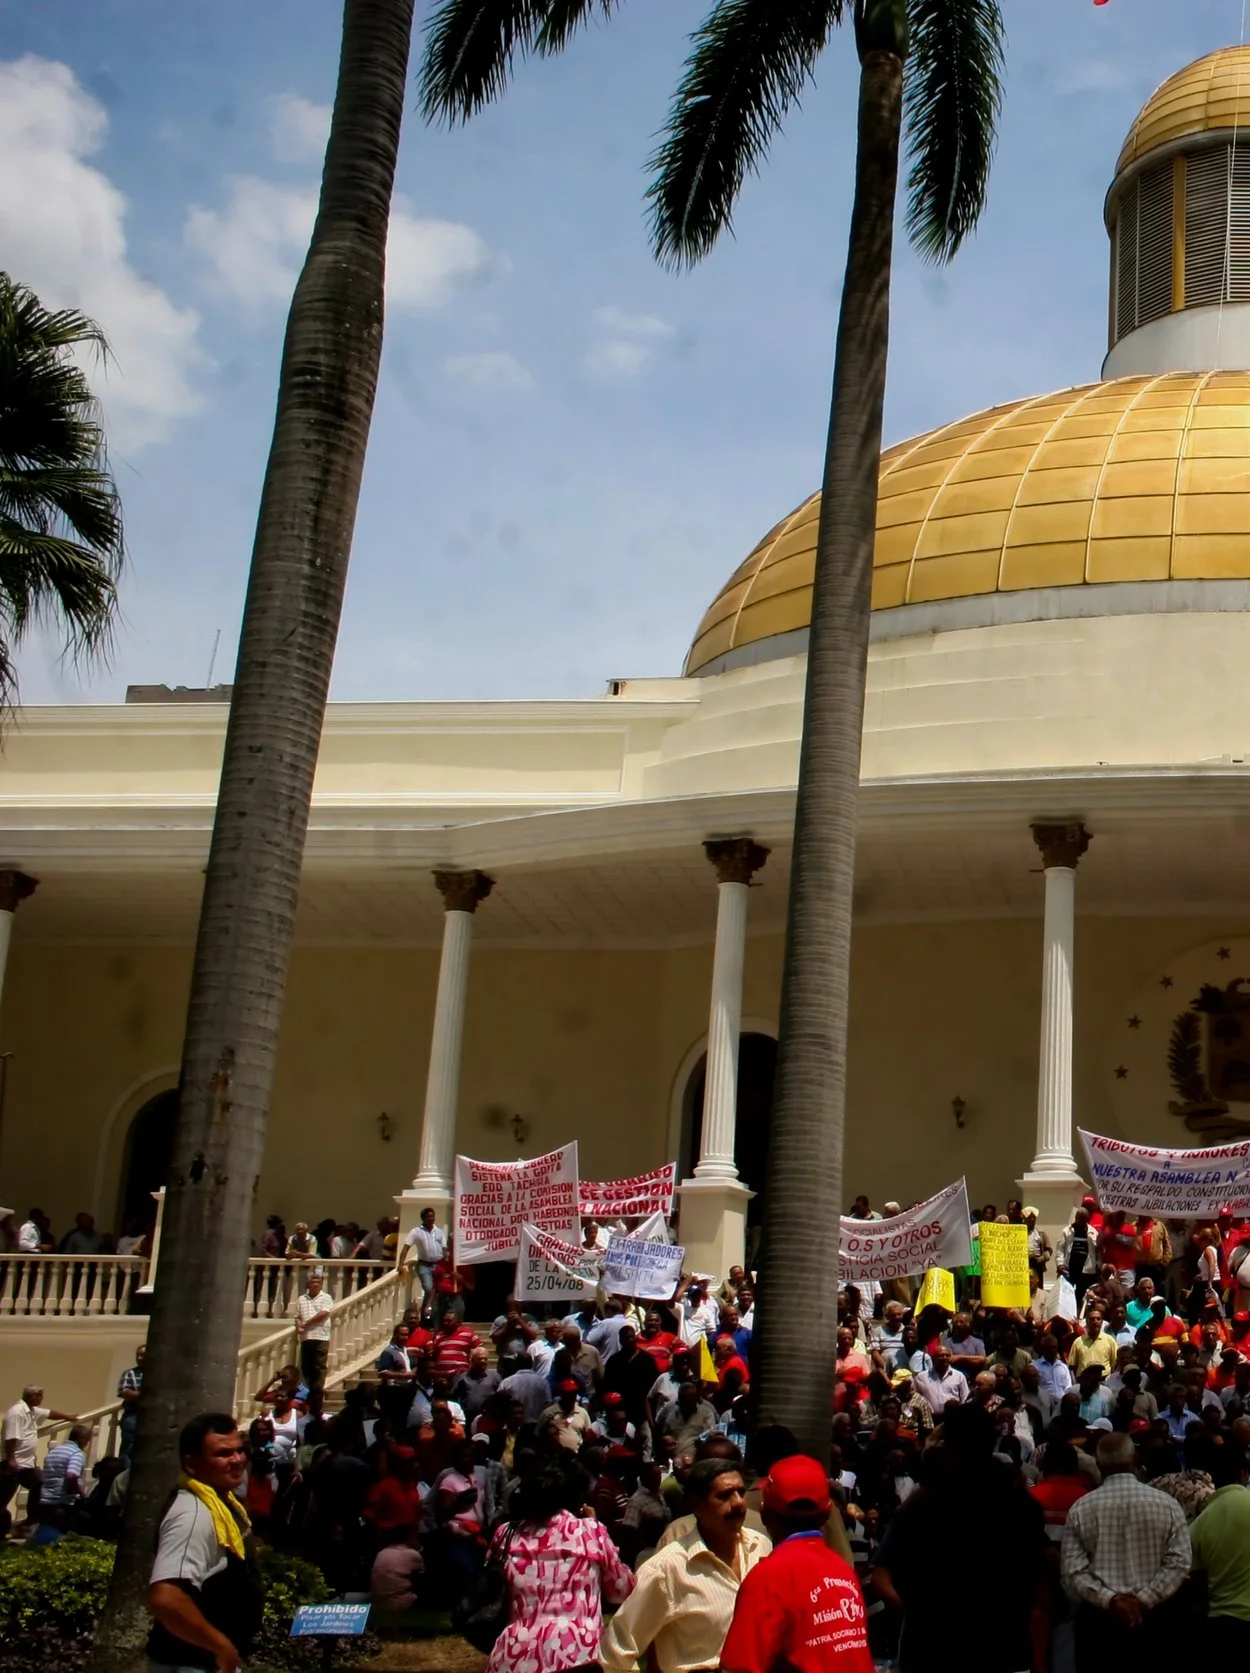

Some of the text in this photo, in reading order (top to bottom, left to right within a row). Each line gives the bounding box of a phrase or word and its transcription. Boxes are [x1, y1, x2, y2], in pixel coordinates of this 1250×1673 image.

[516, 1170, 530, 1180] LA
[1092, 1162, 1147, 1182] NUESTRA
[1150, 1171, 1220, 1185] ASAMBLEA
[460, 1194, 504, 1204] GRACIAS
[506, 1192, 513, 1203] A
[530, 1182, 574, 1198] COMISION
[602, 1182, 672, 1200] GESTION
[1111, 1181, 1125, 1192] SU
[1126, 1184, 1182, 1198] RESPALDO
[460, 1194, 572, 1216] SOCIAL DE LA ASAMBLEA
[592, 1200, 669, 1215] NACIONAL
[1141, 1199, 1200, 1211] JUBILACIONES
[460, 1218, 506, 1228] NACIONAL
[534, 1206, 578, 1220] HABERNOS
[466, 1227, 518, 1240] OTORGADO
[879, 1238, 888, 1250] Y
[892, 1220, 943, 1248] OTROS
[888, 1241, 942, 1262] SOCIAL
[529, 1260, 540, 1272] DE
[546, 1264, 560, 1274] LA
[526, 1276, 584, 1290] 25/04/08
[299, 1604, 367, 1614] Prohibido
